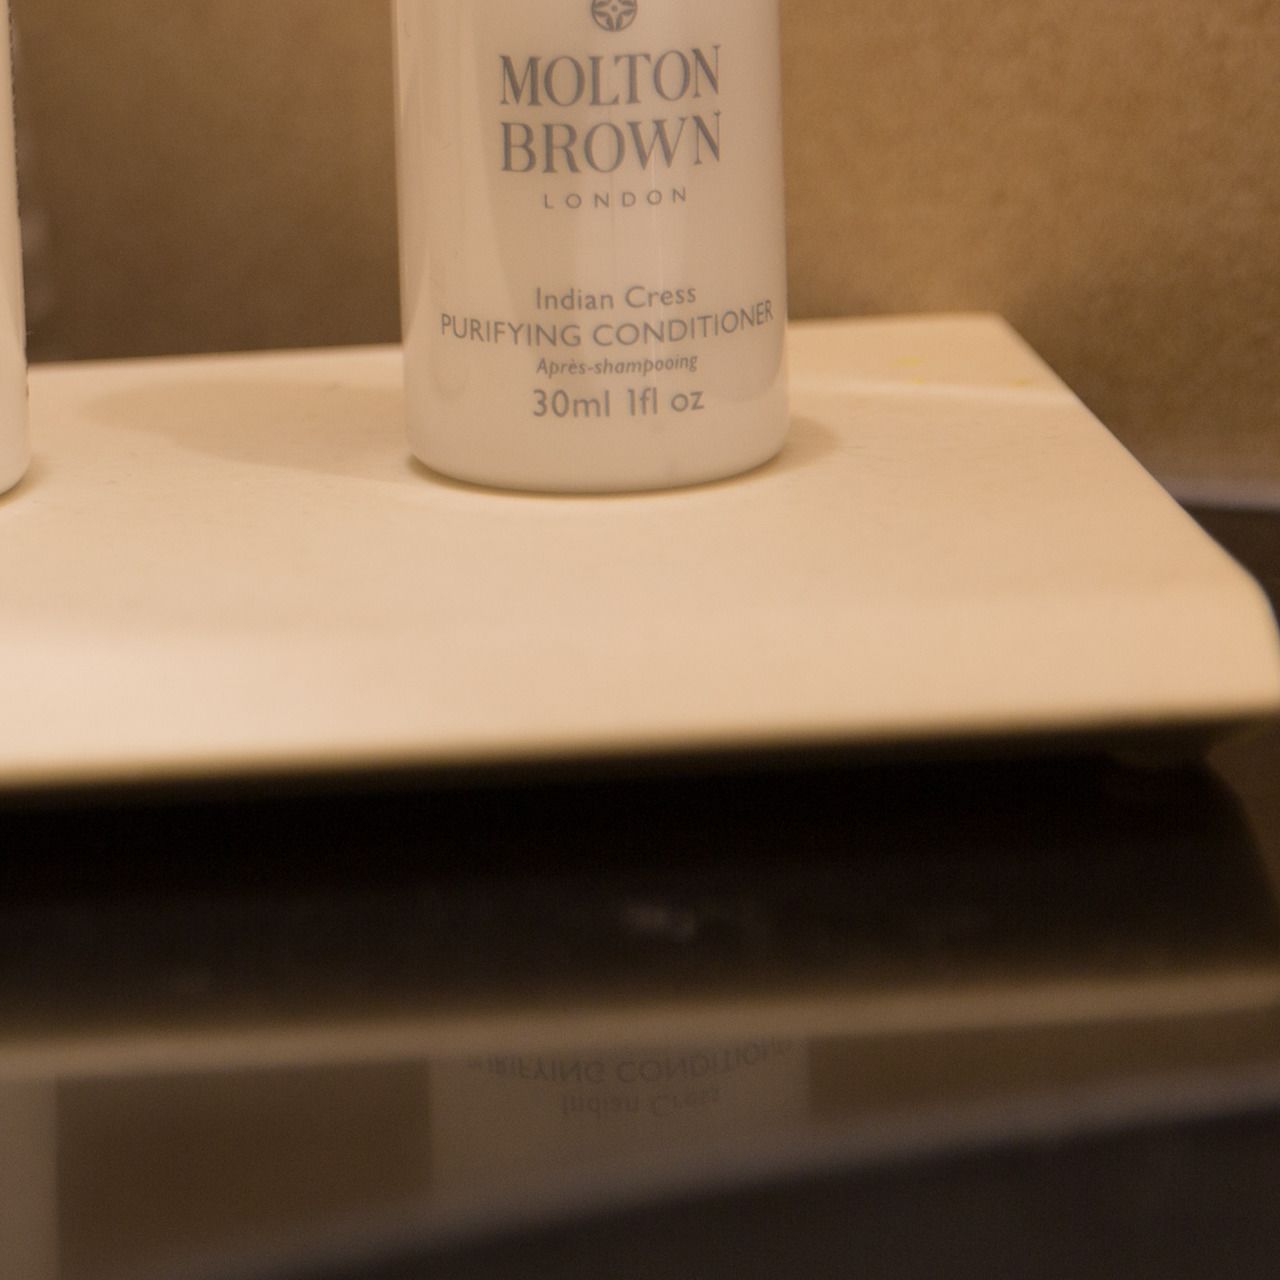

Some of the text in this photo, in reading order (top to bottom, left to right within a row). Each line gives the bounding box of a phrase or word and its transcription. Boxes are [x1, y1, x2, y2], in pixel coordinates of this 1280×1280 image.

[498, 45, 722, 107] MOLTON
[500, 111, 722, 174] BROWN
[543, 187, 688, 209] LONDON
[536, 285, 697, 311] Indian Cress
[440, 299, 774, 348] PURIFYING CONDITIONER
[532, 388, 610, 418] 30ml
[670, 389, 706, 414] oz
